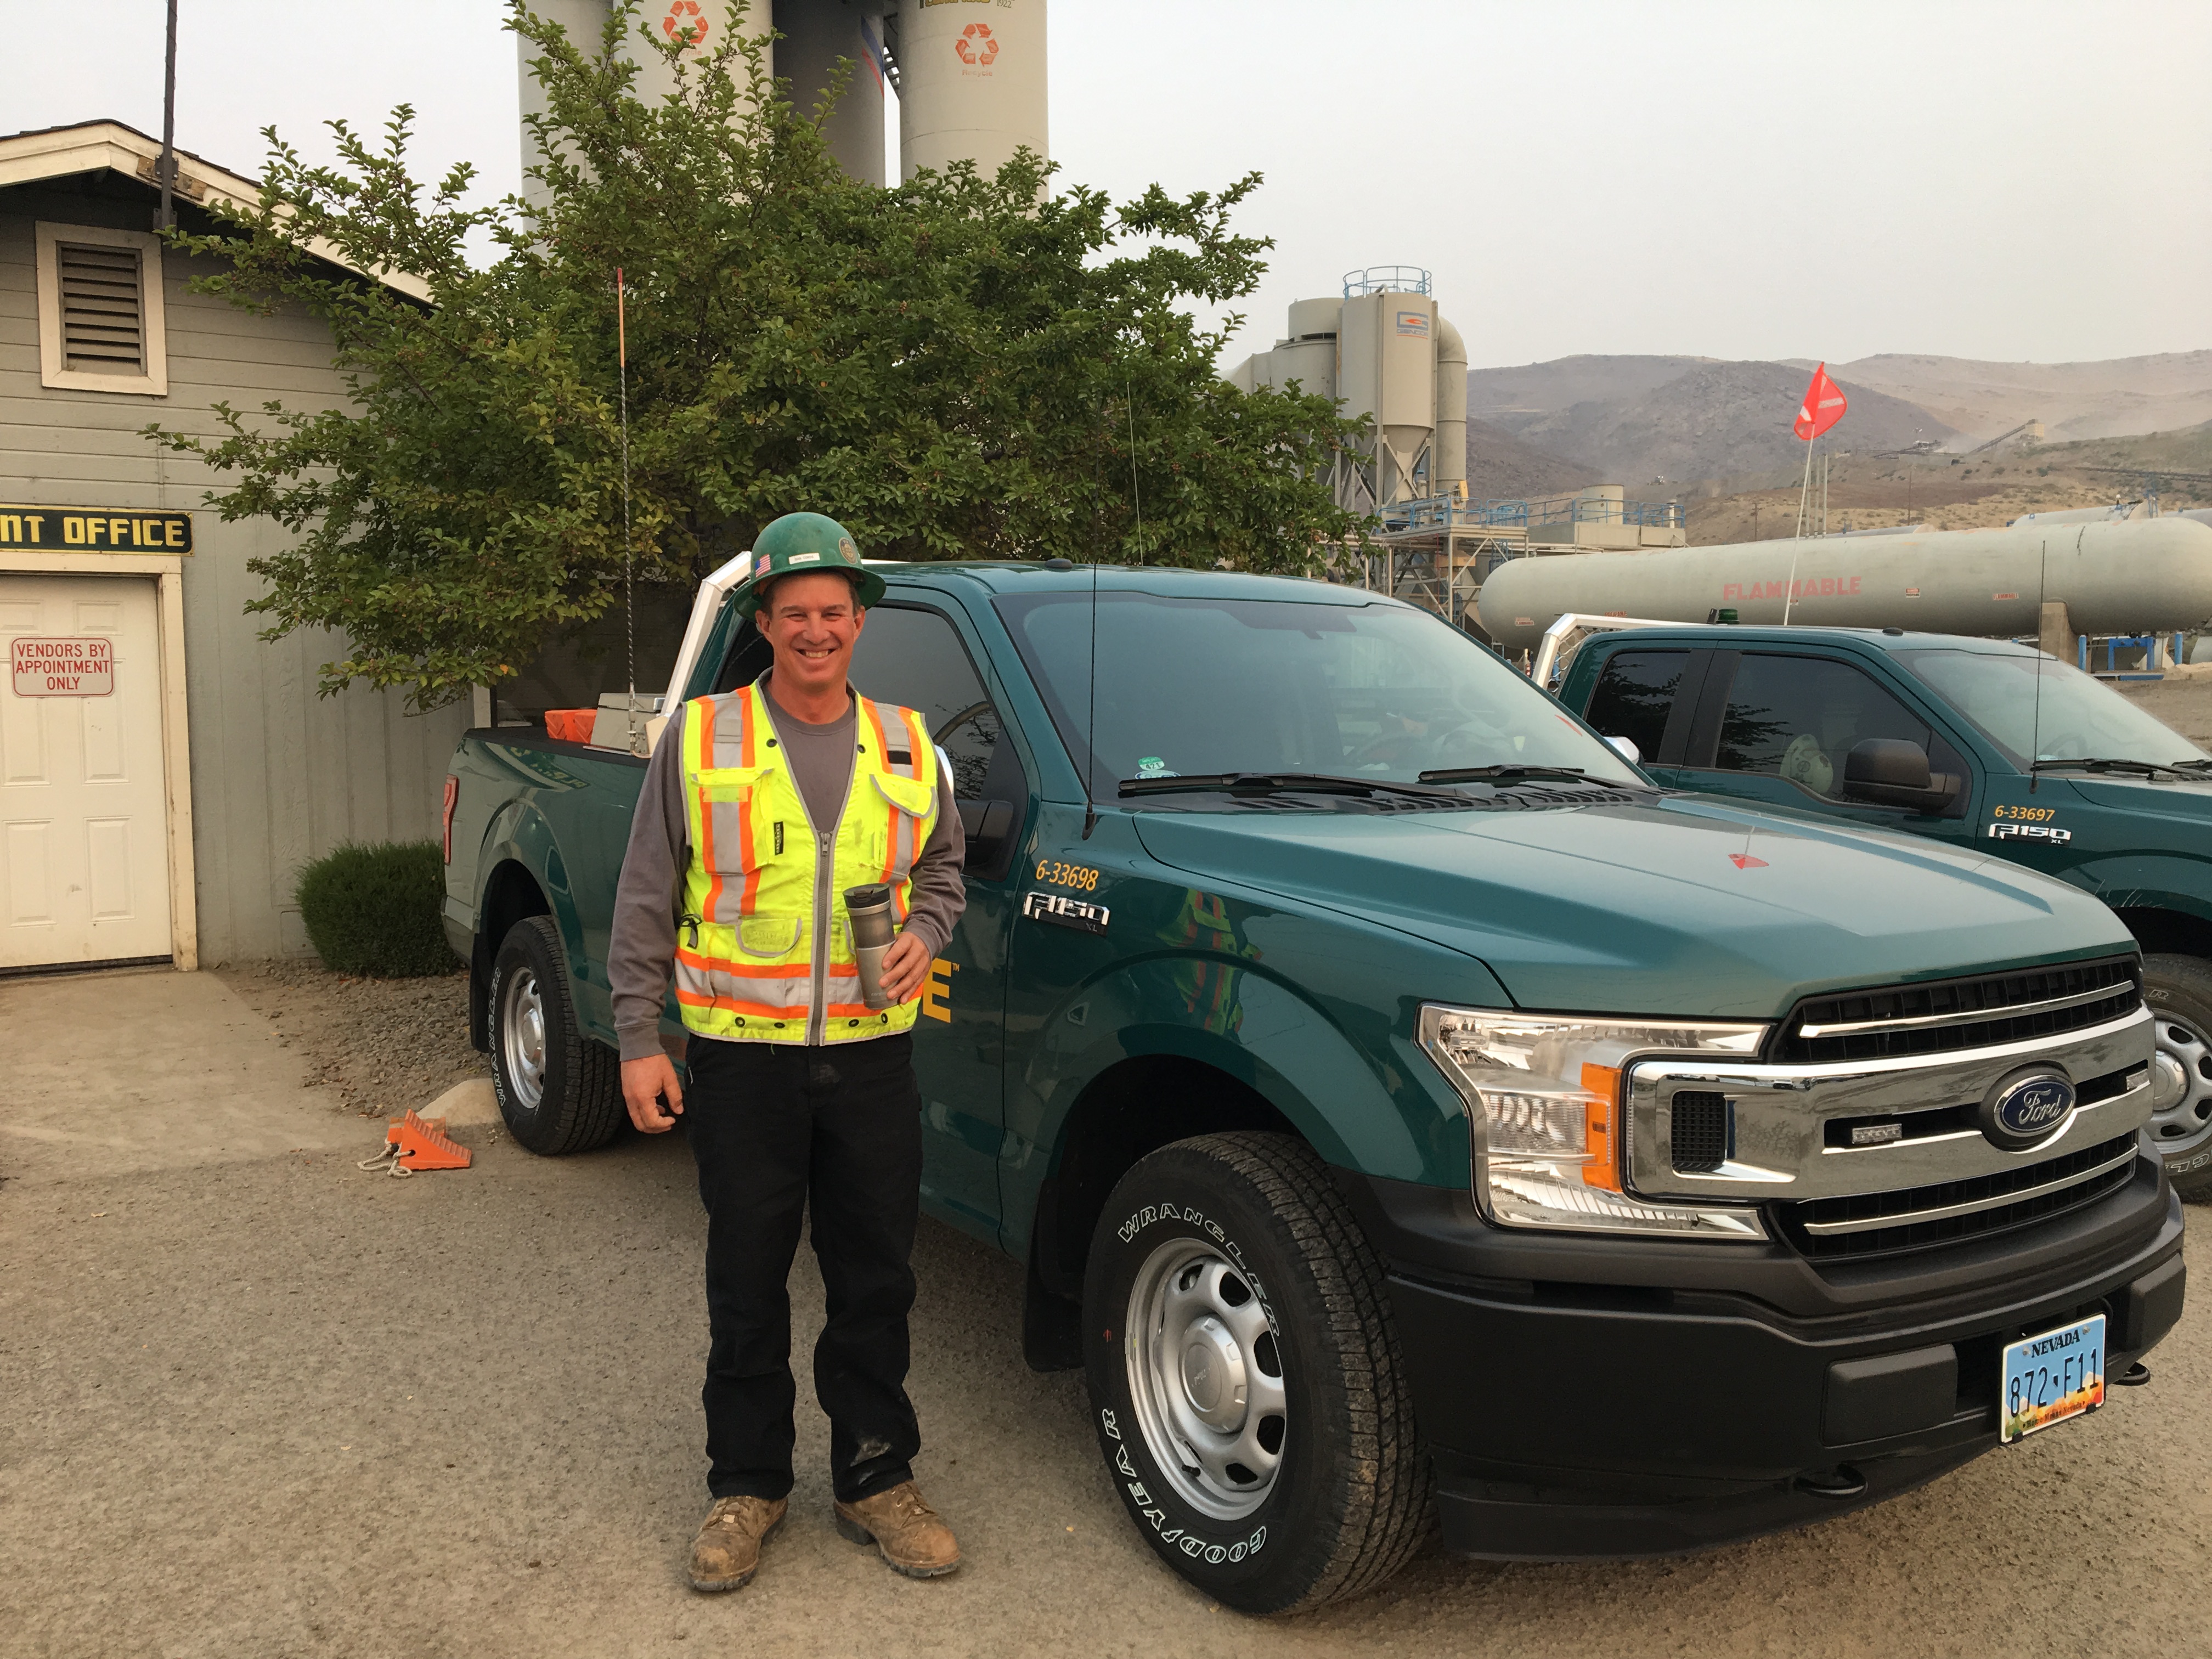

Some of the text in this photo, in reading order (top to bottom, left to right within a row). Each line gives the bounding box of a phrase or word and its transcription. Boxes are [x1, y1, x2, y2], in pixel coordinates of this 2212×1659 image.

[962, 69, 992, 77] Recycle
[63, 517, 186, 547] OFFICE
[1723, 576, 1861, 601] FLAMMABLE
[16, 644, 106, 657] VENDORS BY
[16, 660, 110, 674] APPOINTMENT
[47, 676, 81, 690] ONLY
[1995, 805, 2055, 822] 6-33697
[1036, 859, 1099, 891] 6-33698
[1086, 923, 1097, 932] XL
[2019, 1088, 2062, 1125] Ford
[1118, 1203, 1280, 1337] WRANGLER
[2031, 1329, 2081, 1358] NEVADA
[2045, 1410, 2062, 1421] Means
[2063, 1402, 2082, 1414] Nevada
[1102, 1408, 1267, 1564] GOODYEAR
